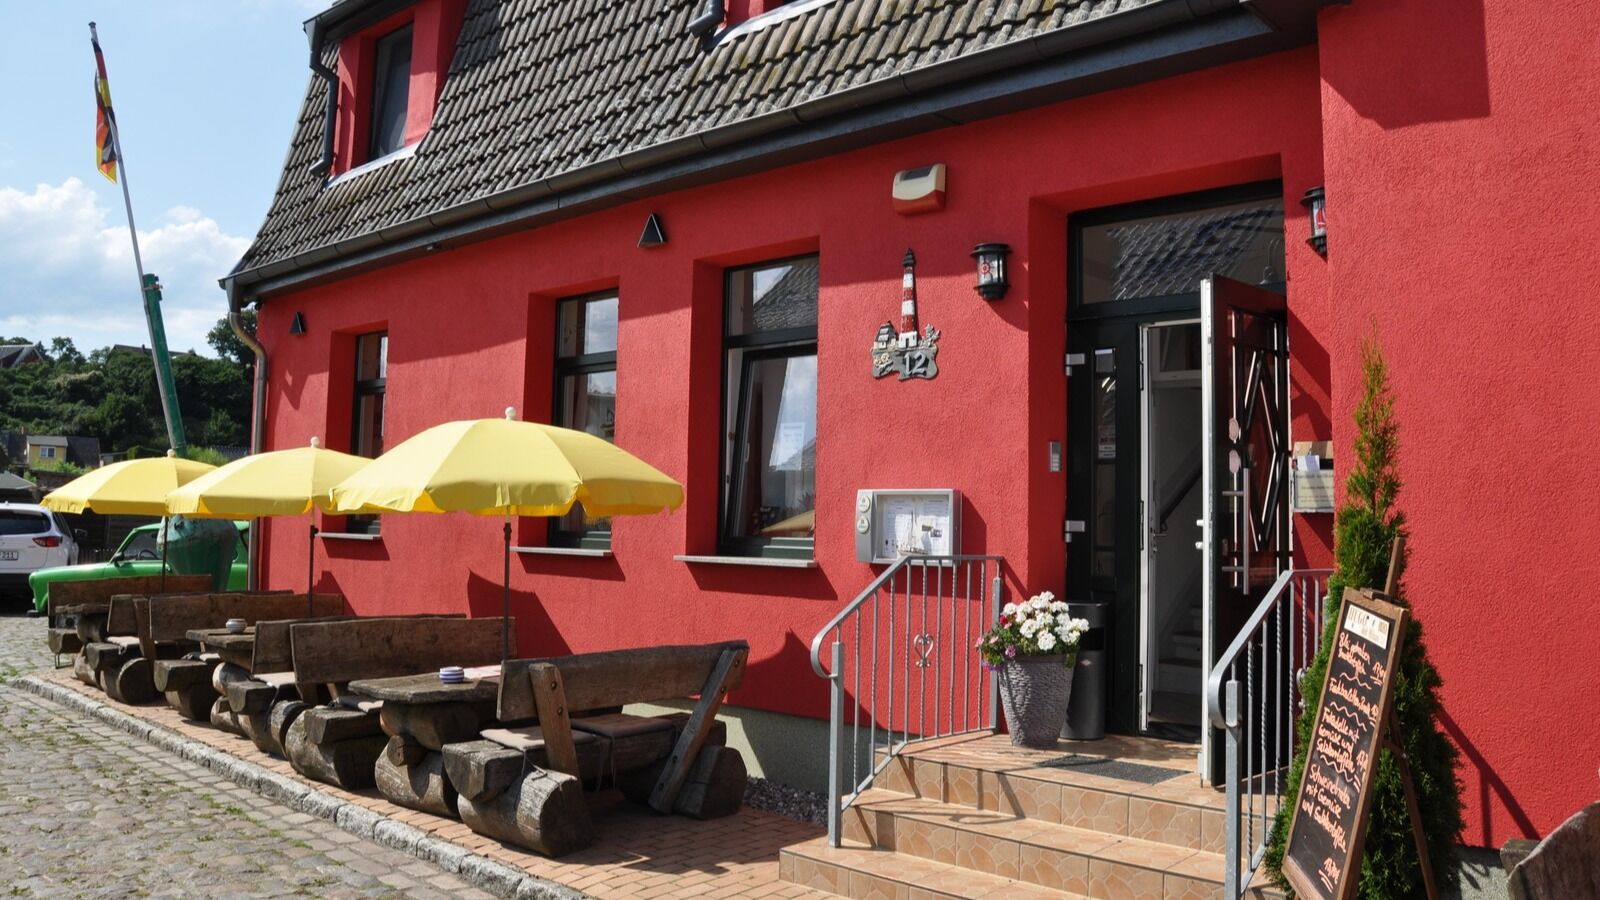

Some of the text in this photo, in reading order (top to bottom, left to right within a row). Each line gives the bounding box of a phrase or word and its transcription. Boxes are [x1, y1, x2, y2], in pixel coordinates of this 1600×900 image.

[904, 351, 926, 374] 12
[1341, 739, 1354, 760] und
[1302, 799, 1315, 817] und
[1306, 784, 1342, 819] mit Gemüse
